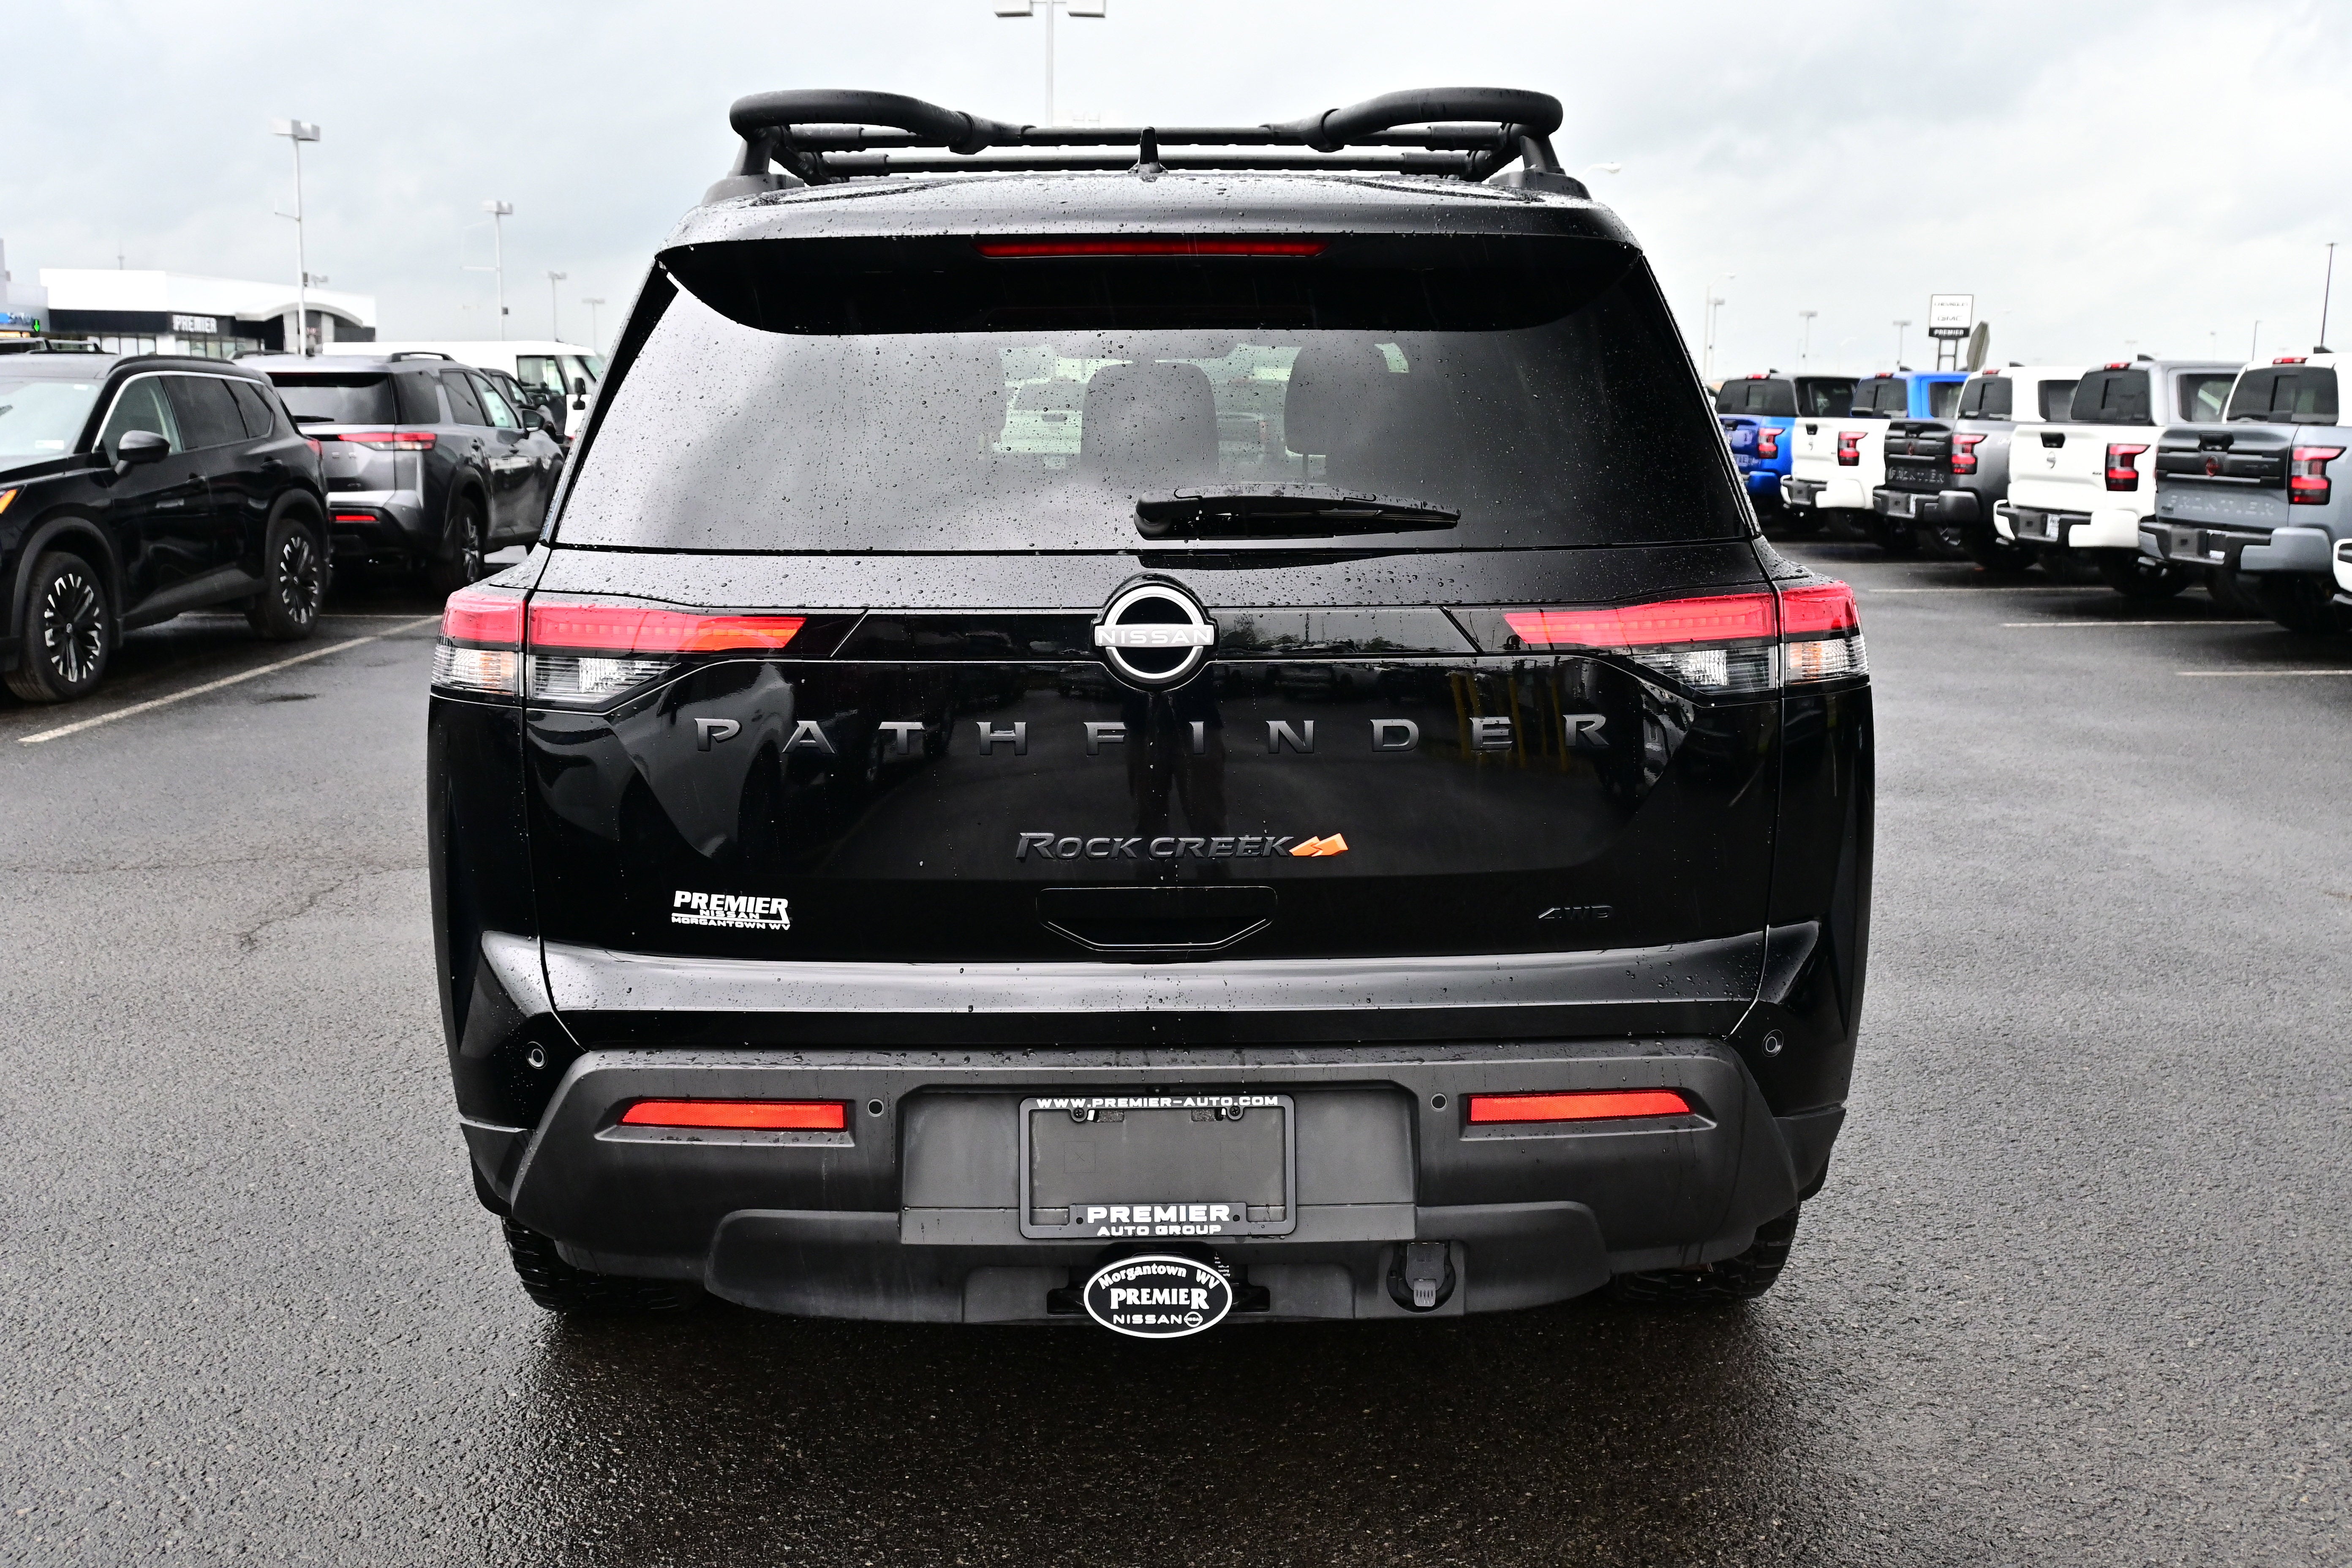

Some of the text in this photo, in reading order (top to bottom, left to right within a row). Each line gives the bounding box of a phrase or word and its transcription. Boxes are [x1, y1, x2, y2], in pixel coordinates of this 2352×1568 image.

[172, 314, 218, 334] PREMIER
[1098, 629, 1211, 644] NISSAN
[694, 713, 1610, 756] PATHFINDER
[1015, 832, 1295, 860] ROCK CREEK
[673, 890, 790, 921] PREMIER
[700, 909, 760, 920] NISSAN
[671, 916, 766, 929] MORGANTOWN
[1037, 1096, 1278, 1108] WWW.PREMIER-AUTO.COM
[1087, 1205, 1230, 1224] PREMIER
[1097, 1225, 1222, 1236] AUTO GROUP
[1098, 1263, 1187, 1290] Morgantown
[1196, 1269, 1220, 1289] WV
[1110, 1288, 1210, 1309] PREMIER
[1113, 1315, 1182, 1324] NISSAN
